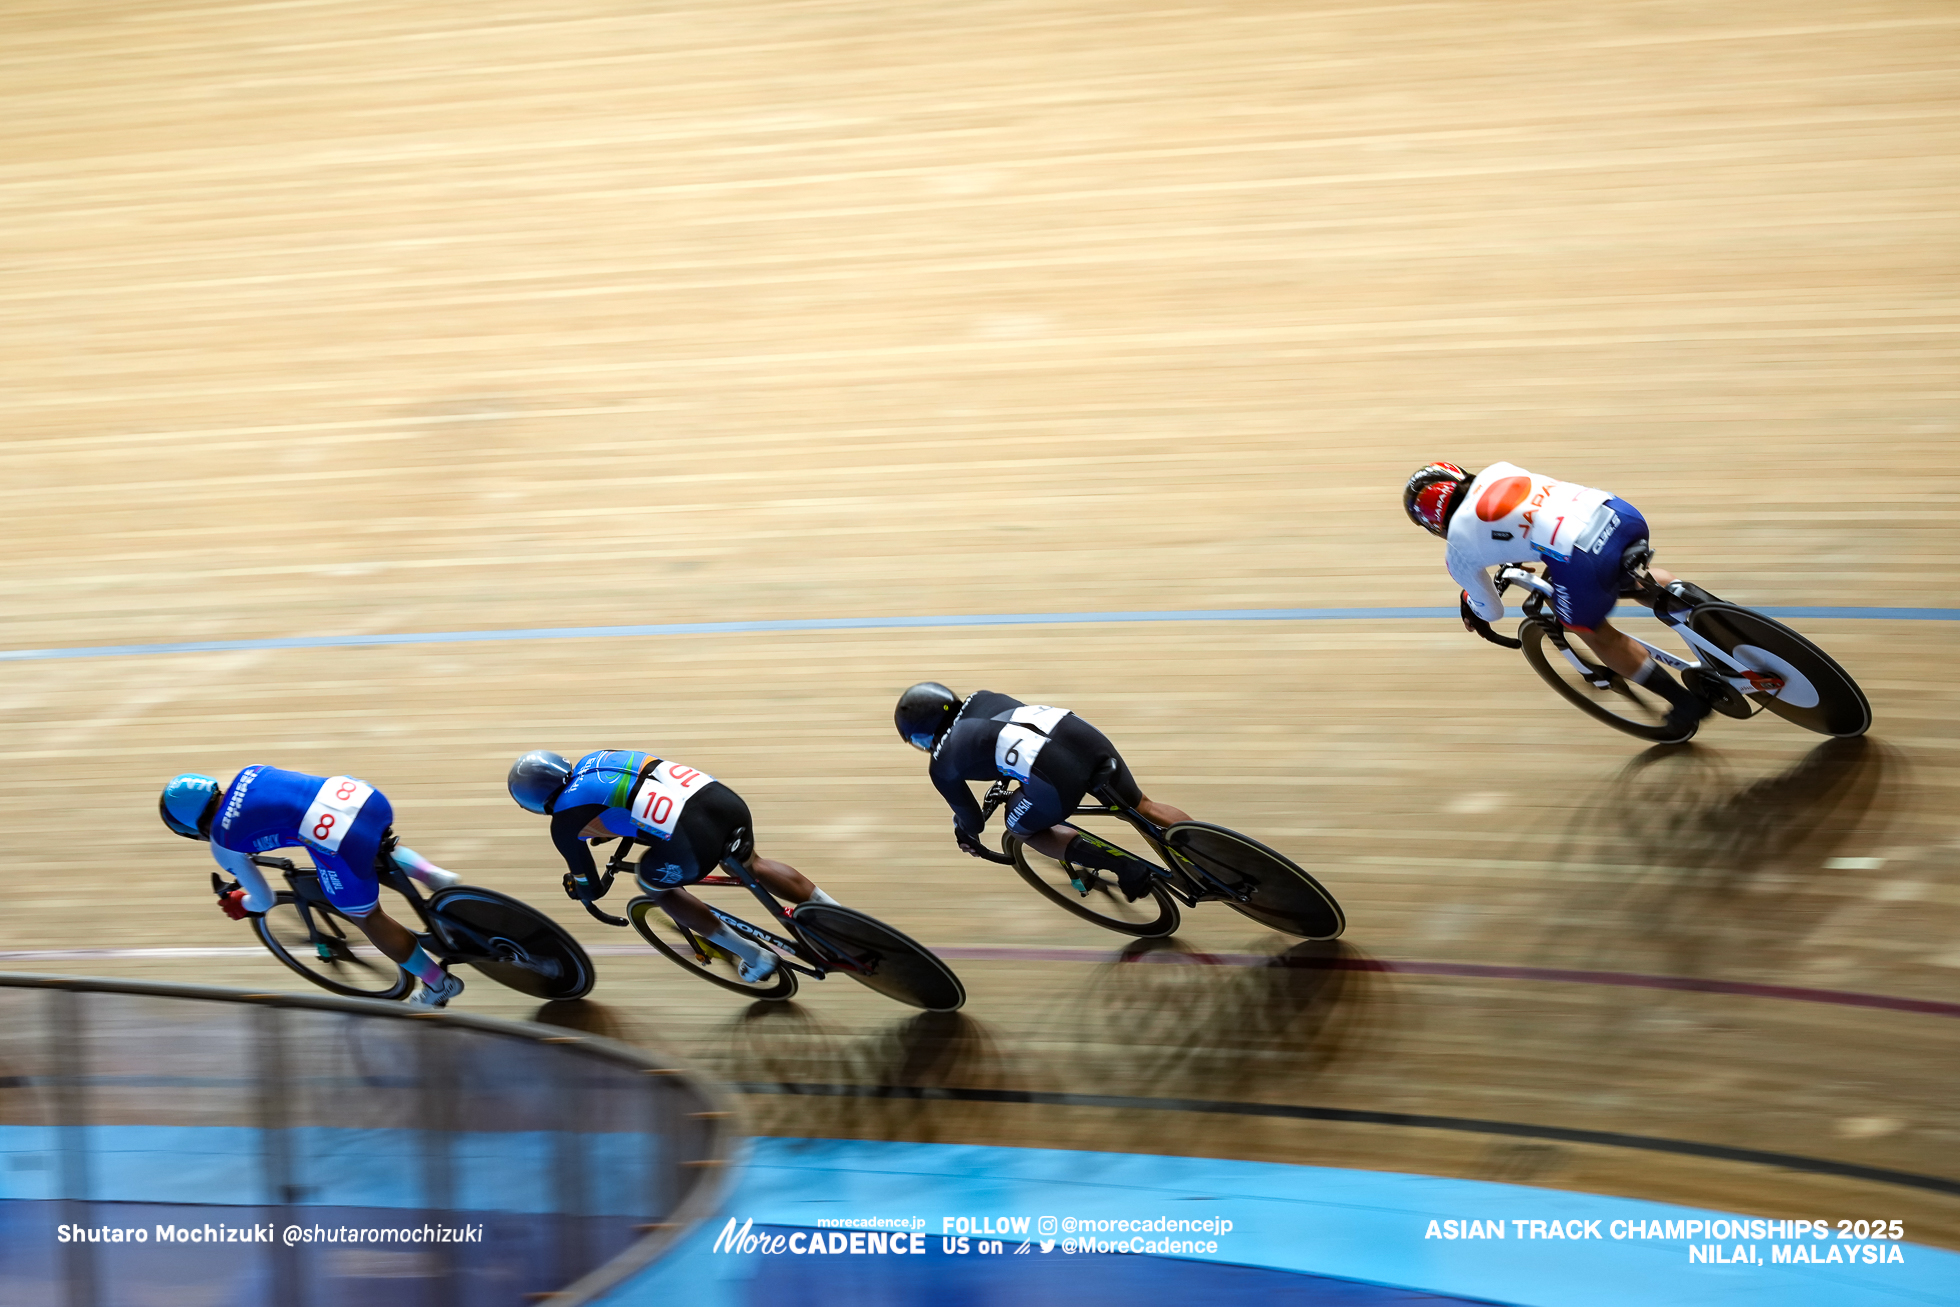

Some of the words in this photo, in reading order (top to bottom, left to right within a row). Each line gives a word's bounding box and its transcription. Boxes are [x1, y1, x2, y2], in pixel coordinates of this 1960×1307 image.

[1434, 484, 1453, 522] JAPAN
[1518, 479, 1562, 540] JAPA
[1549, 516, 1565, 546] 1
[1592, 513, 1621, 556] Q36.5
[1004, 738, 1024, 767] 6
[336, 781, 357, 801] 8
[642, 791, 674, 825] 10
[313, 814, 336, 841] 8
